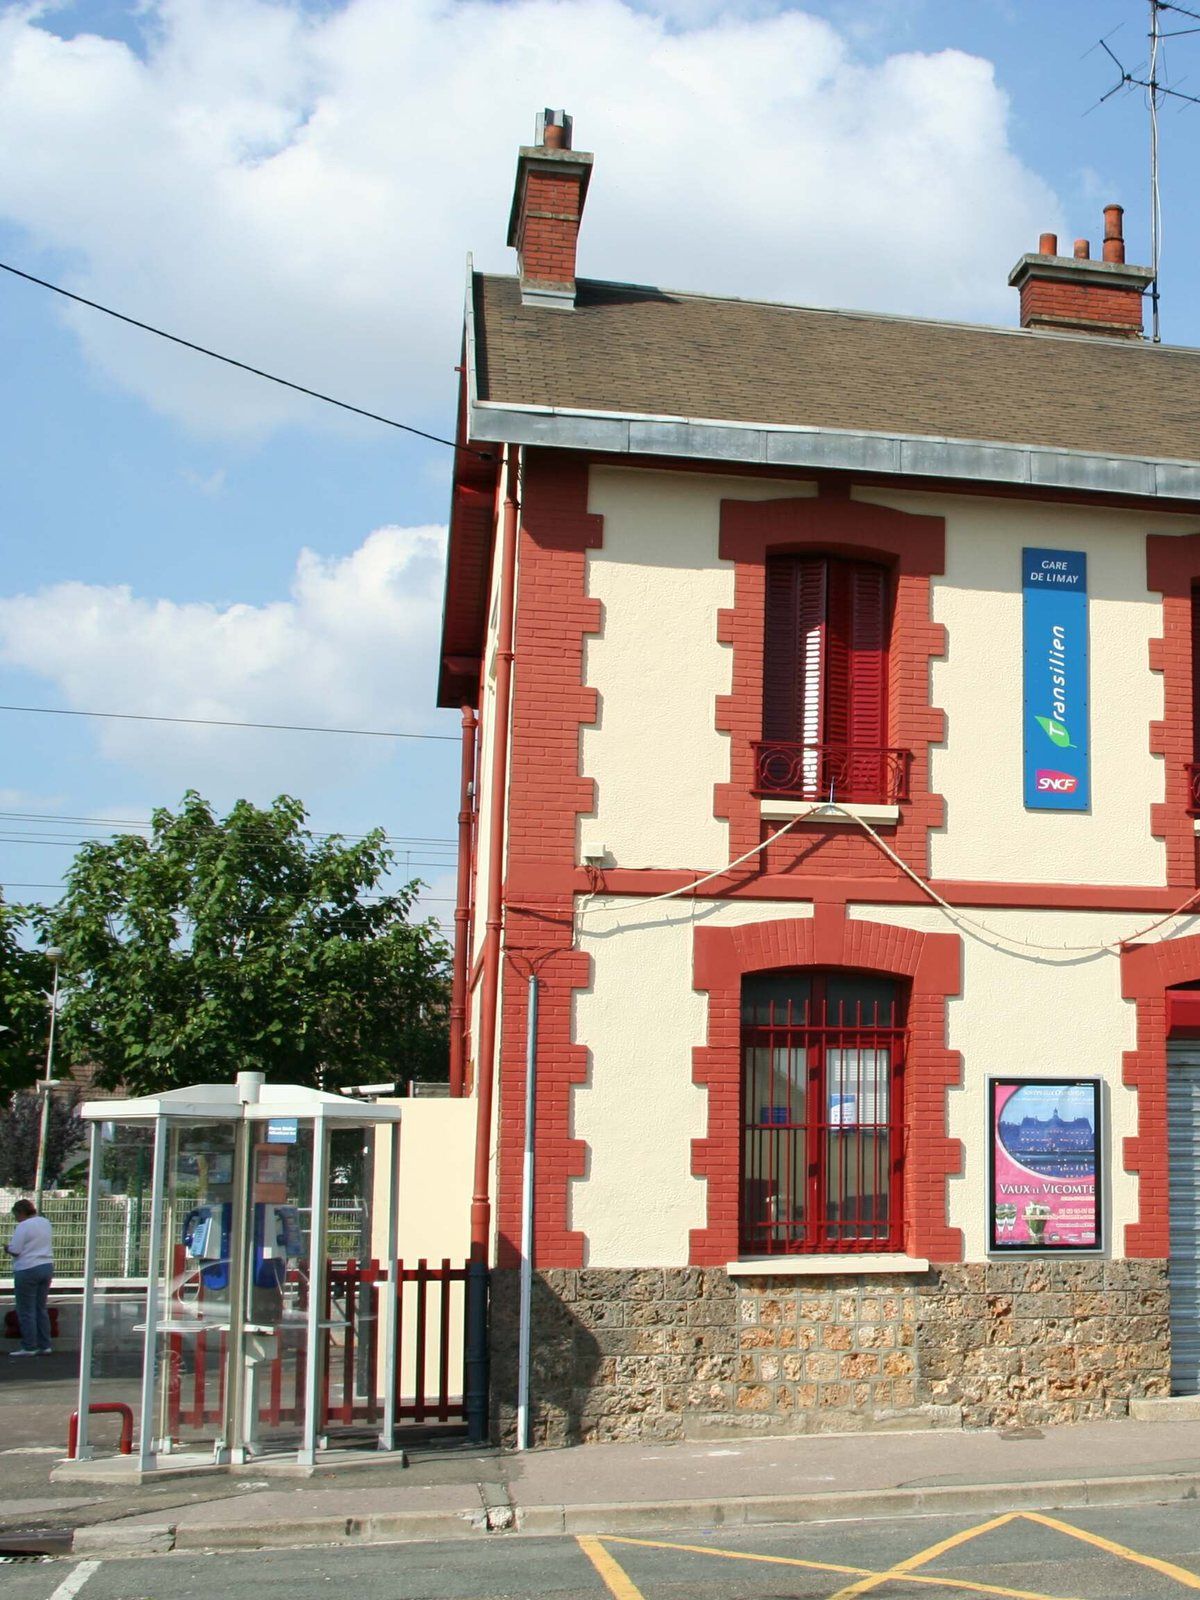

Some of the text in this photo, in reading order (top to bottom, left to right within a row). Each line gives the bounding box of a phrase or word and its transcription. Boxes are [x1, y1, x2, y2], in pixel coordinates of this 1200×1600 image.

[1041, 560, 1068, 570] GARE
[1030, 572, 1079, 583] DE LIMAY
[1049, 625, 1065, 736] Transilien
[1037, 777, 1076, 790] SNCF
[1000, 1183, 1030, 1194] VAUX
[1043, 1183, 1095, 1194] VICOMTE
